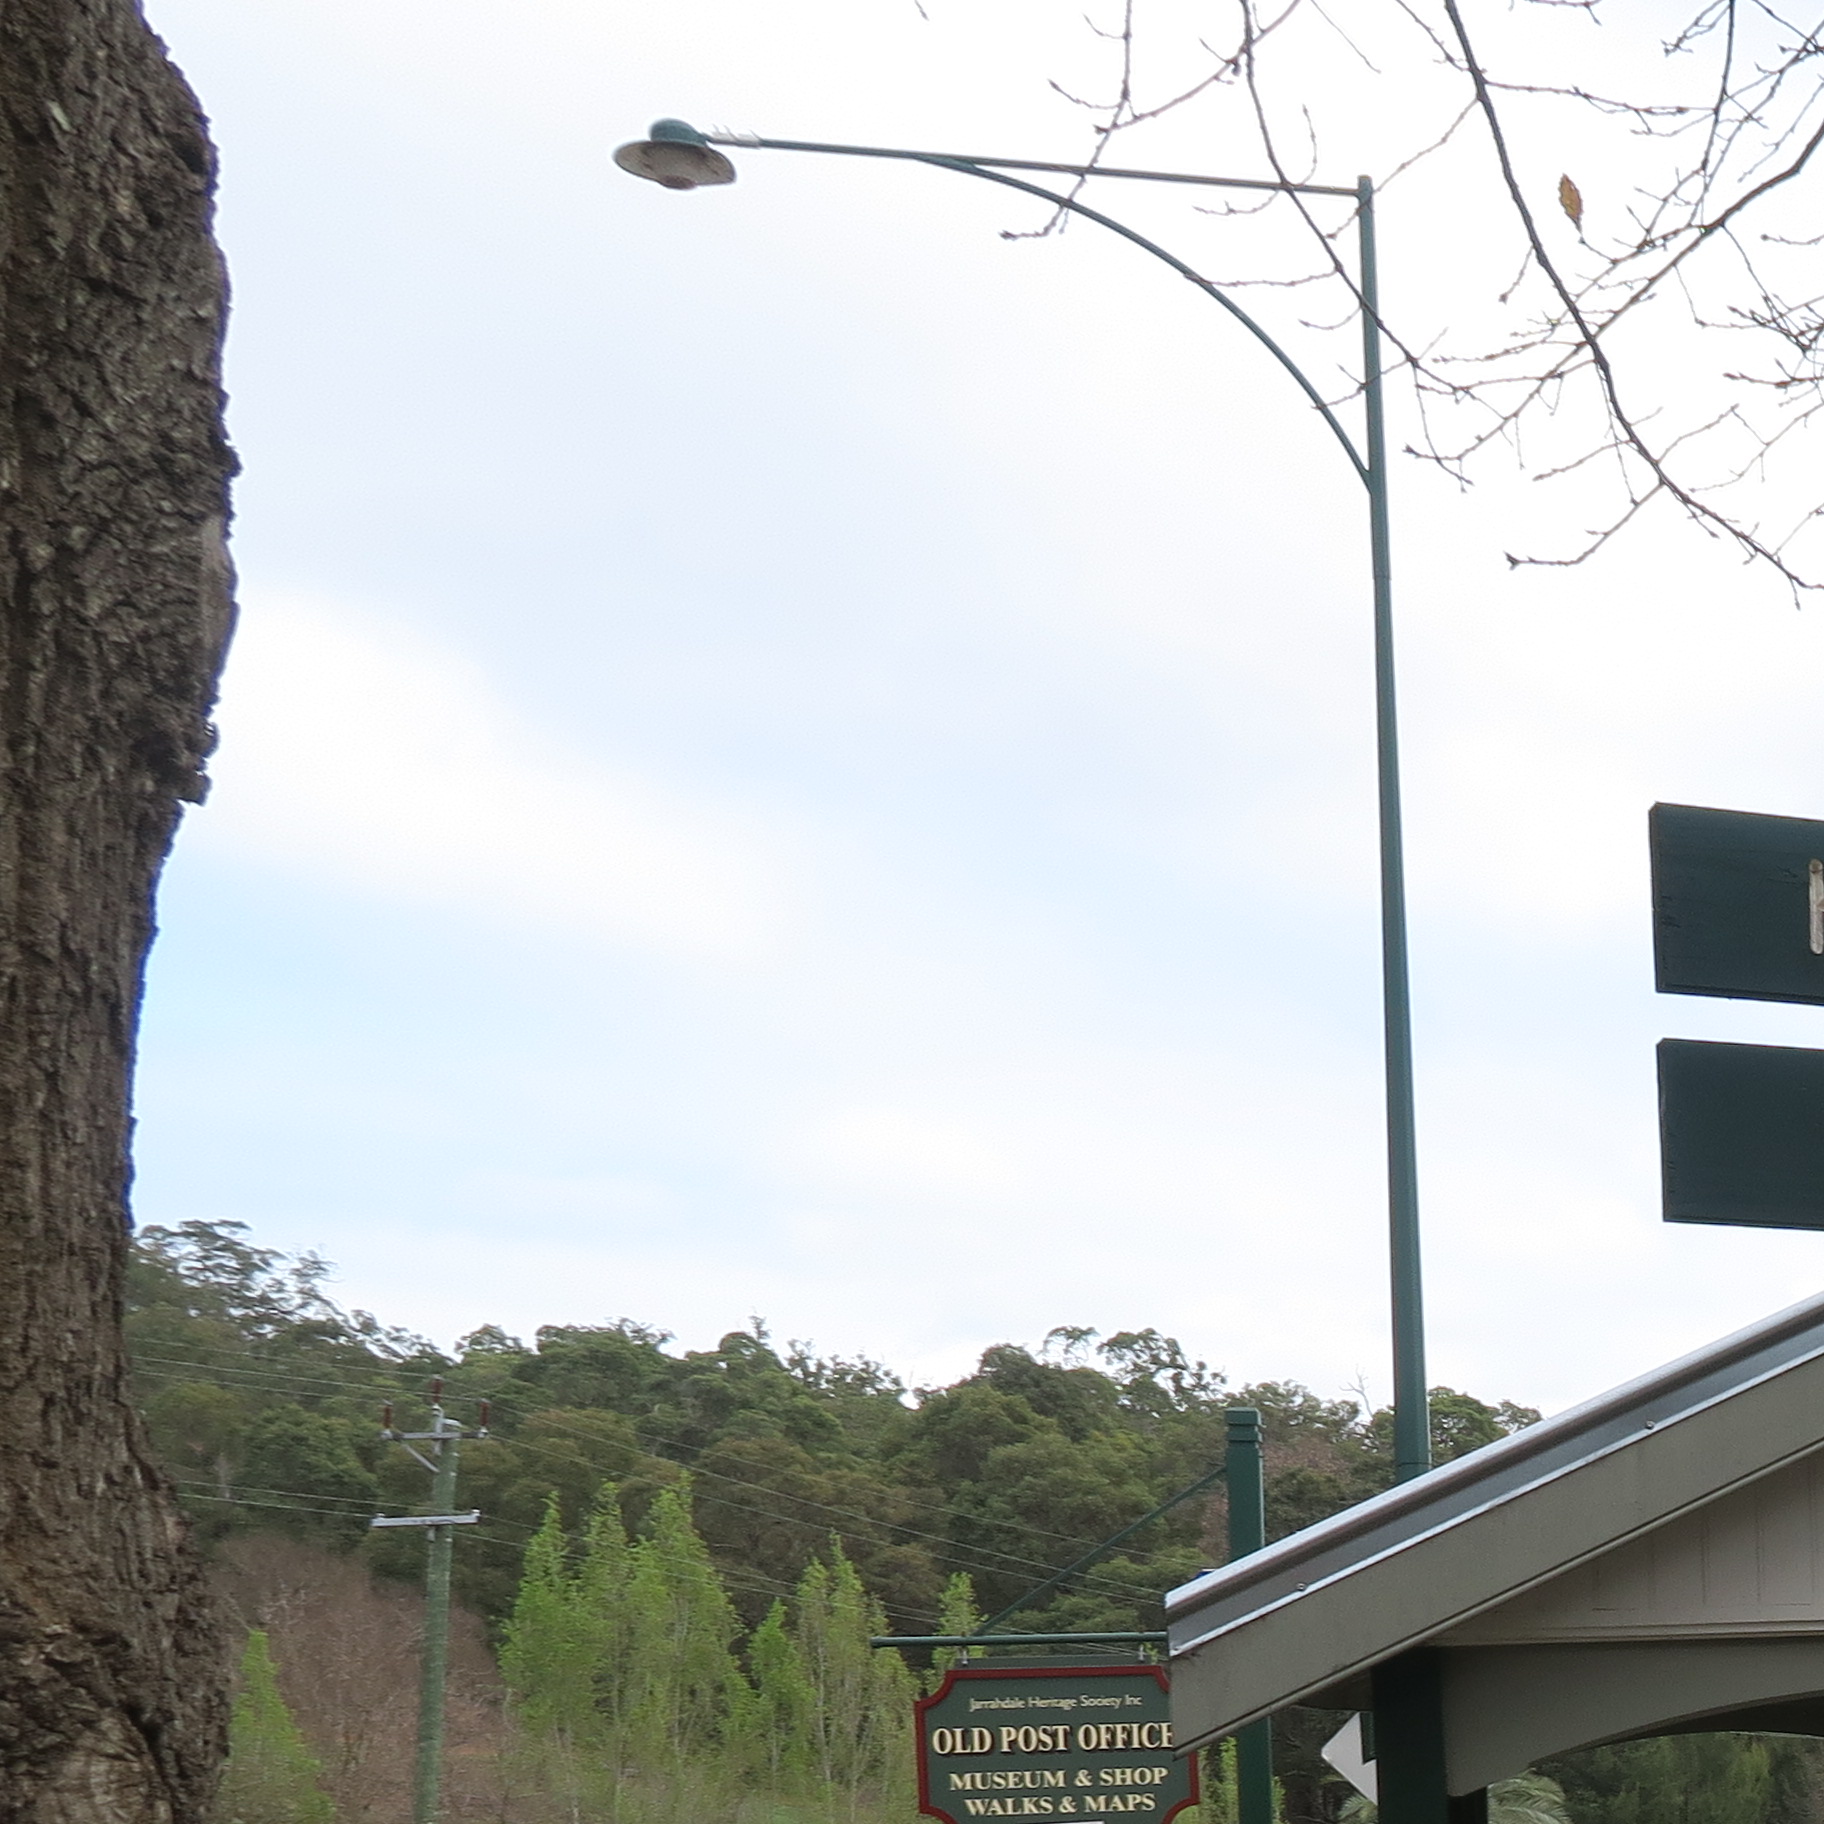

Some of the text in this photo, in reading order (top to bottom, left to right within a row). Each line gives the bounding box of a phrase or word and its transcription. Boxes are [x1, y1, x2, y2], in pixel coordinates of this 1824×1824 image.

[969, 1694, 1142, 1712] Jarrahdale Heritage Society Inc
[932, 1726, 993, 1755] OLD
[998, 1724, 1072, 1753] POST
[949, 1766, 1169, 1791] MUSEUM & SHOP
[964, 1792, 1156, 1816] WALKS & MAPS
